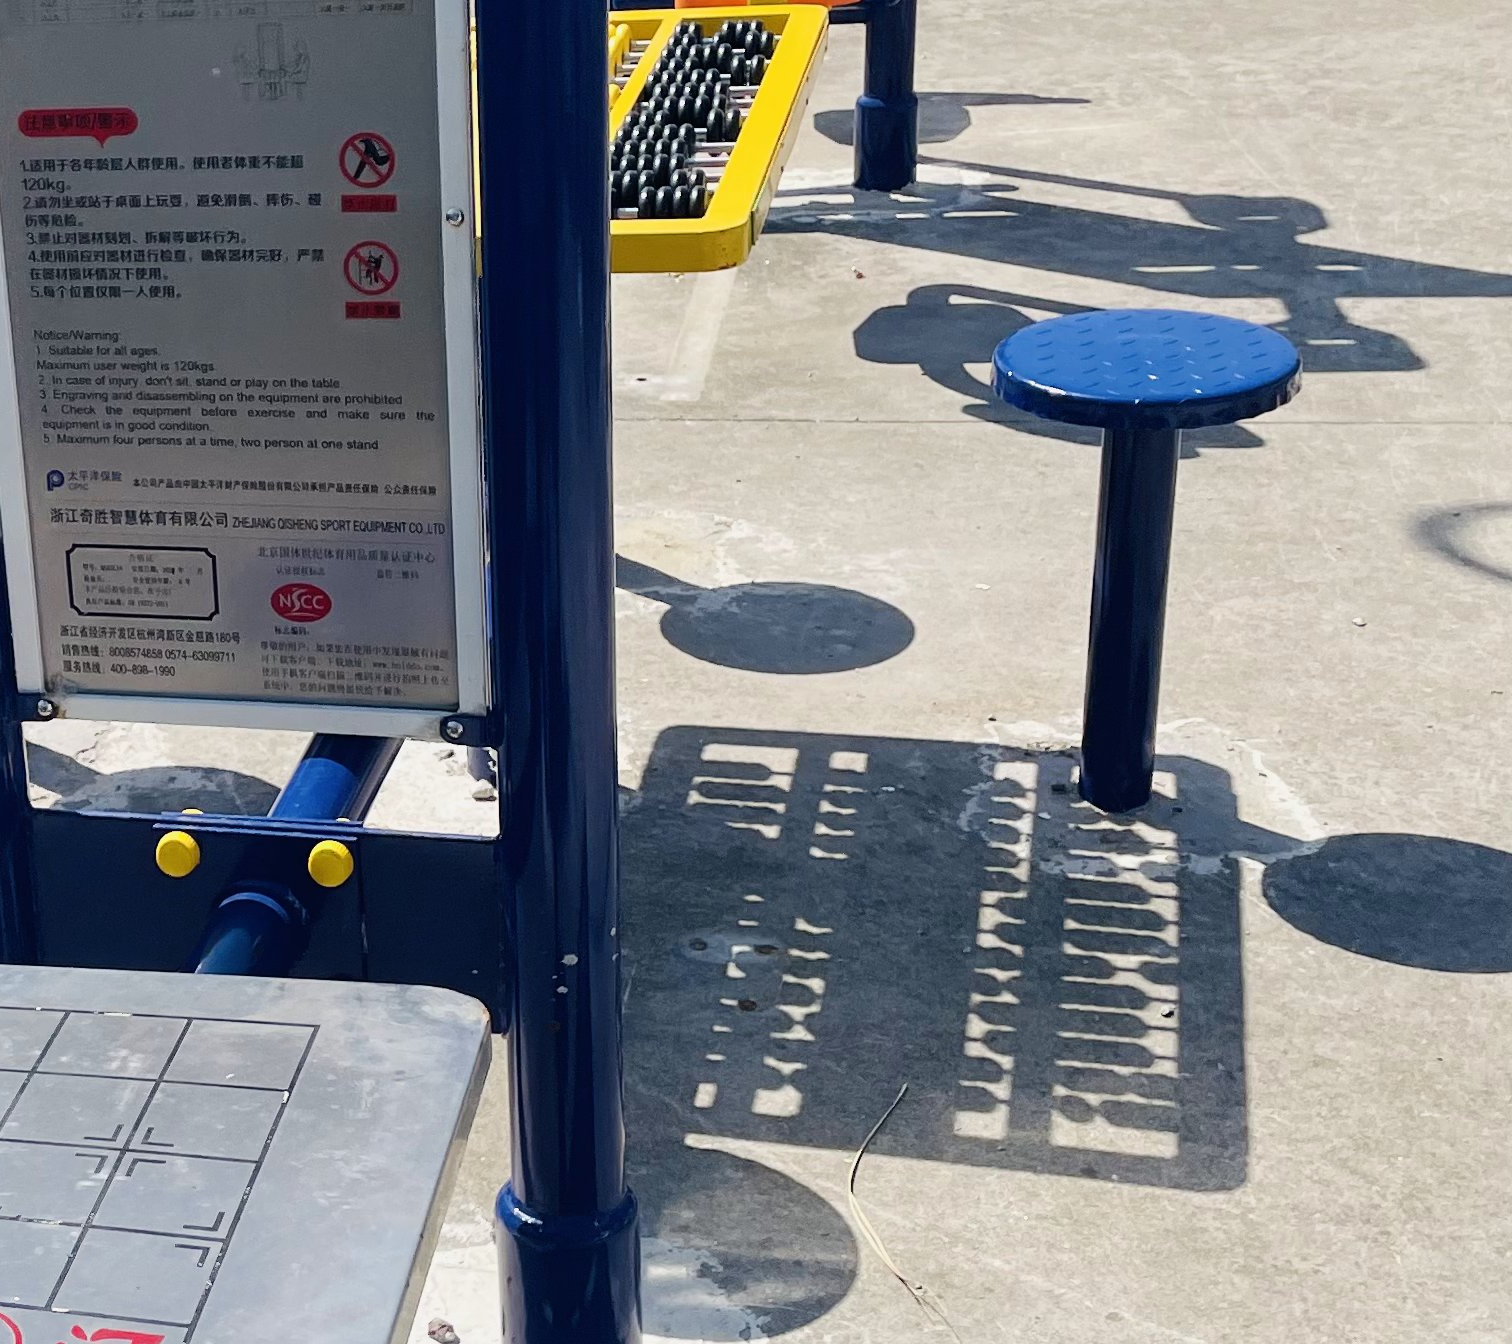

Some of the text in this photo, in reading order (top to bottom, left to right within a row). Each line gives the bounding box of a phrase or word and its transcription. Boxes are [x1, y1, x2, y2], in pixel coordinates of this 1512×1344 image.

[48, 346, 94, 356] Suitable
[96, 346, 110, 356] for
[114, 346, 127, 356] all
[36, 360, 91, 371] Maximum
[93, 362, 117, 371] user
[120, 361, 158, 373] weight
[160, 362, 170, 372] is
[52, 375, 63, 386] In
[66, 377, 92, 386] case
[95, 375, 106, 386] of
[145, 376, 173, 387] don't
[195, 376, 227, 388] stand
[230, 379, 242, 388] or
[245, 377, 269, 389] play
[272, 379, 287, 388] on
[290, 378, 308, 389] the
[52, 390, 109, 403] Engraving
[111, 391, 133, 401] and
[136, 391, 216, 404] disassembling
[219, 393, 234, 402] on
[237, 392, 255, 402] the
[258, 393, 319, 405] equipment
[322, 395, 341, 404] are
[344, 395, 403, 405] prohibited
[61, 404, 96, 415] Check
[105, 405, 123, 416] the
[132, 406, 192, 418] equipment
[201, 406, 237, 417] before
[247, 409, 296, 419] exercise
[305, 409, 328, 419] and
[337, 409, 370, 420] make
[379, 411, 406, 420] sure
[416, 410, 436, 421] the
[42, 420, 99, 431] equipment
[102, 420, 112, 430] is
[114, 420, 125, 431] in
[127, 420, 156, 432] good
[56, 433, 110, 445] Maximum
[113, 433, 134, 445] four
[137, 436, 183, 447] persons
[185, 435, 196, 446] at
[199, 436, 207, 446] a
[240, 438, 261, 448] two
[264, 439, 304, 450] person
[306, 438, 318, 449] at
[321, 440, 343, 450] one
[346, 439, 379, 450] stand
[68, 469, 122, 483] 太平洋保险
[50, 507, 229, 529] 浙江奇胜智慧体育有限公司
[232, 516, 276, 530] ZHEJIANG
[320, 519, 352, 533] SPORT
[353, 520, 407, 534] EQUIPMENT
